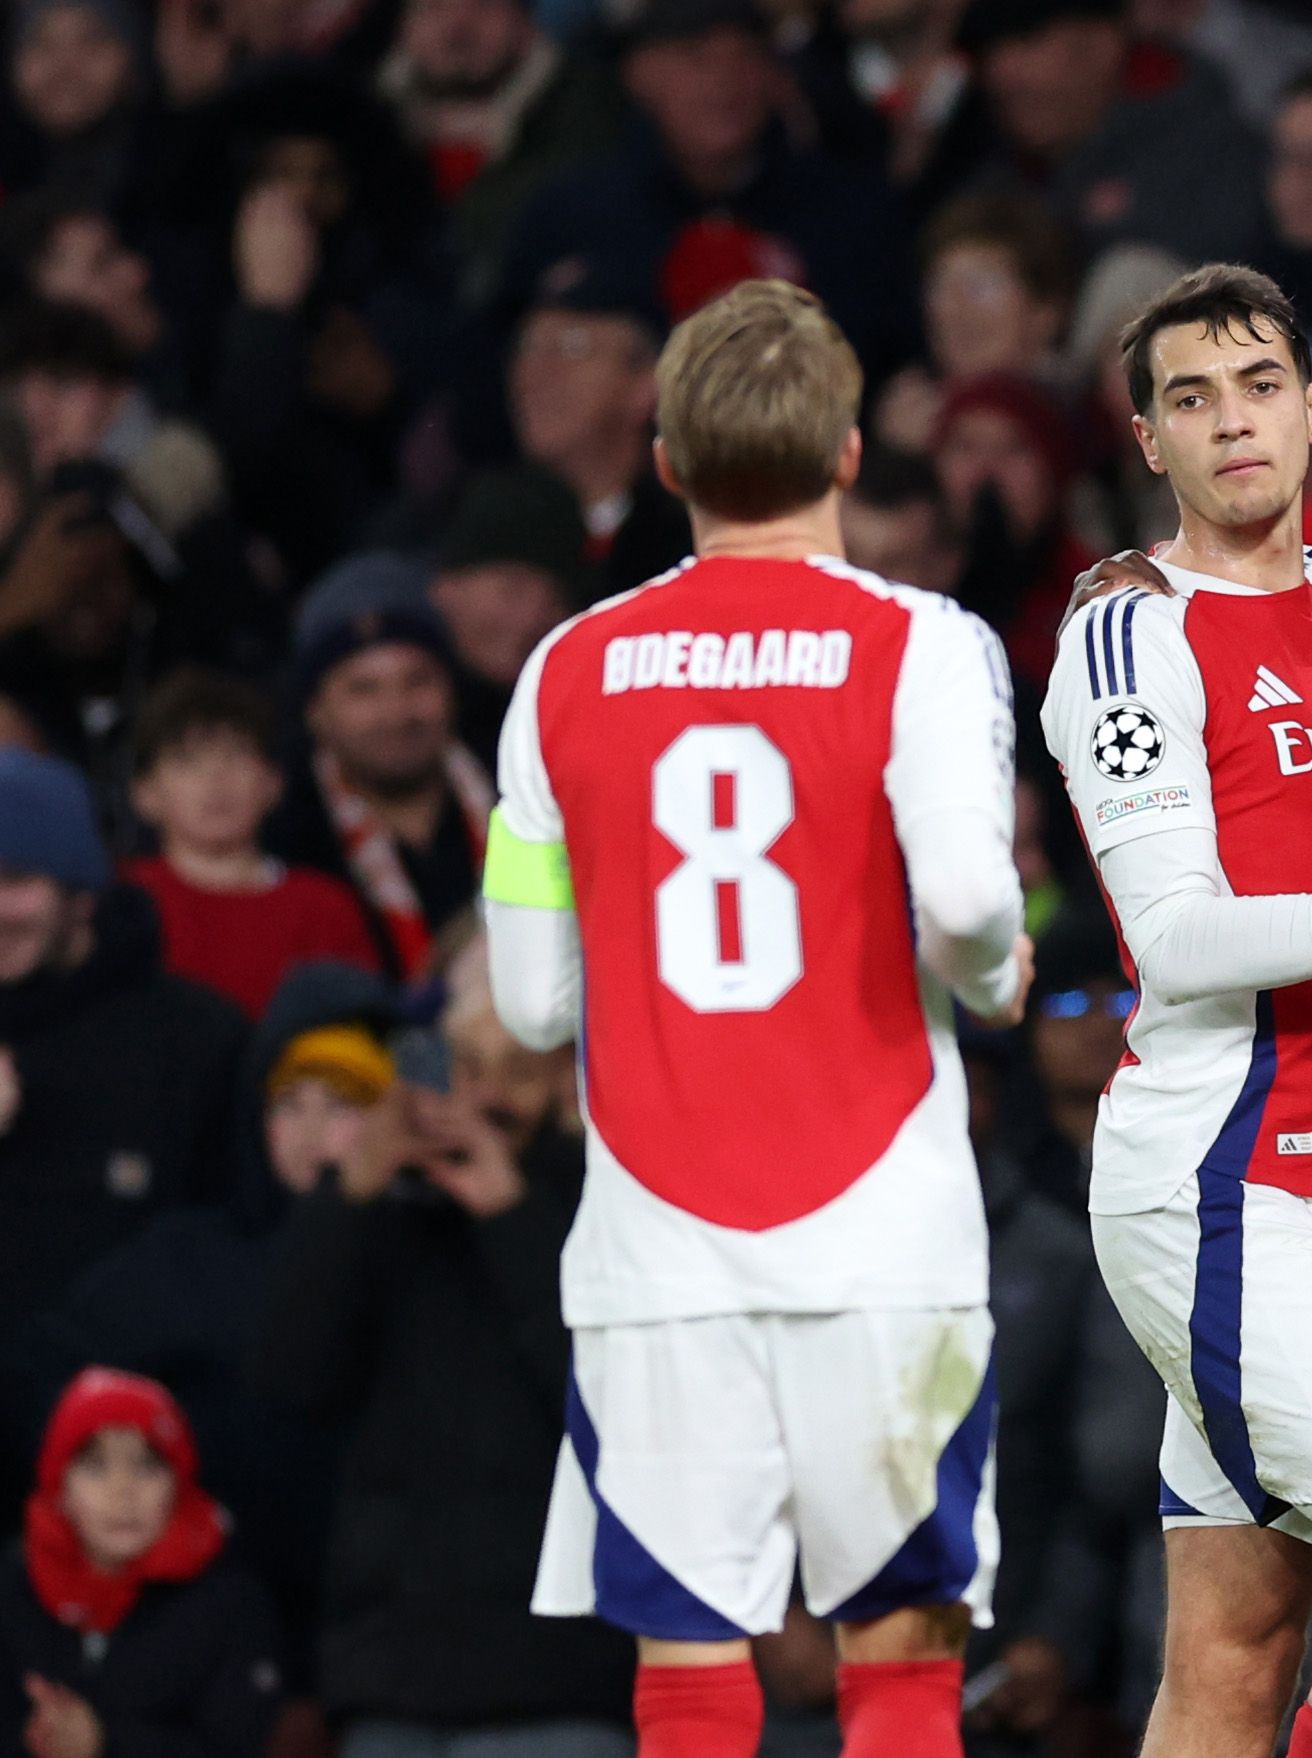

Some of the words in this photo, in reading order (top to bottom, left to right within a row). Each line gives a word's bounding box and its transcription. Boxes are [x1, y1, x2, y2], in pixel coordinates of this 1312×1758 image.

[602, 629, 852, 695] ØDEGAARD
[1097, 788, 1190, 822] FOUNDATION
[650, 722, 805, 1014] 8
